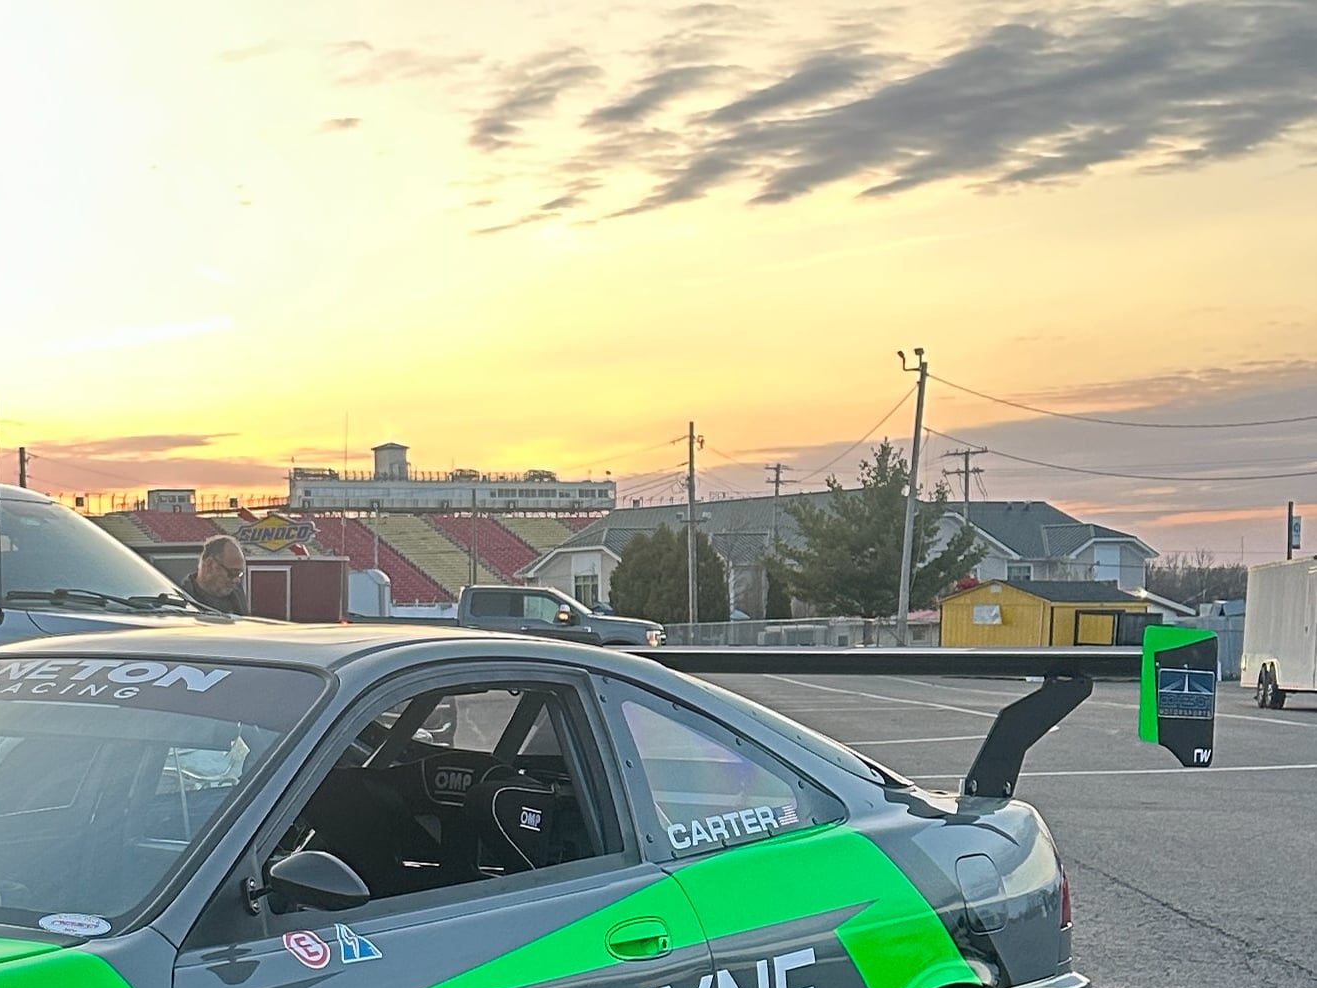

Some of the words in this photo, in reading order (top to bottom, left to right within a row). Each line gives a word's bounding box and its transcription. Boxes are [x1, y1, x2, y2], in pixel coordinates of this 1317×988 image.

[239, 525, 312, 542] SUNOCO
[435, 771, 472, 791] OMP
[520, 811, 541, 827] OMP
[667, 806, 779, 849] CARTER
